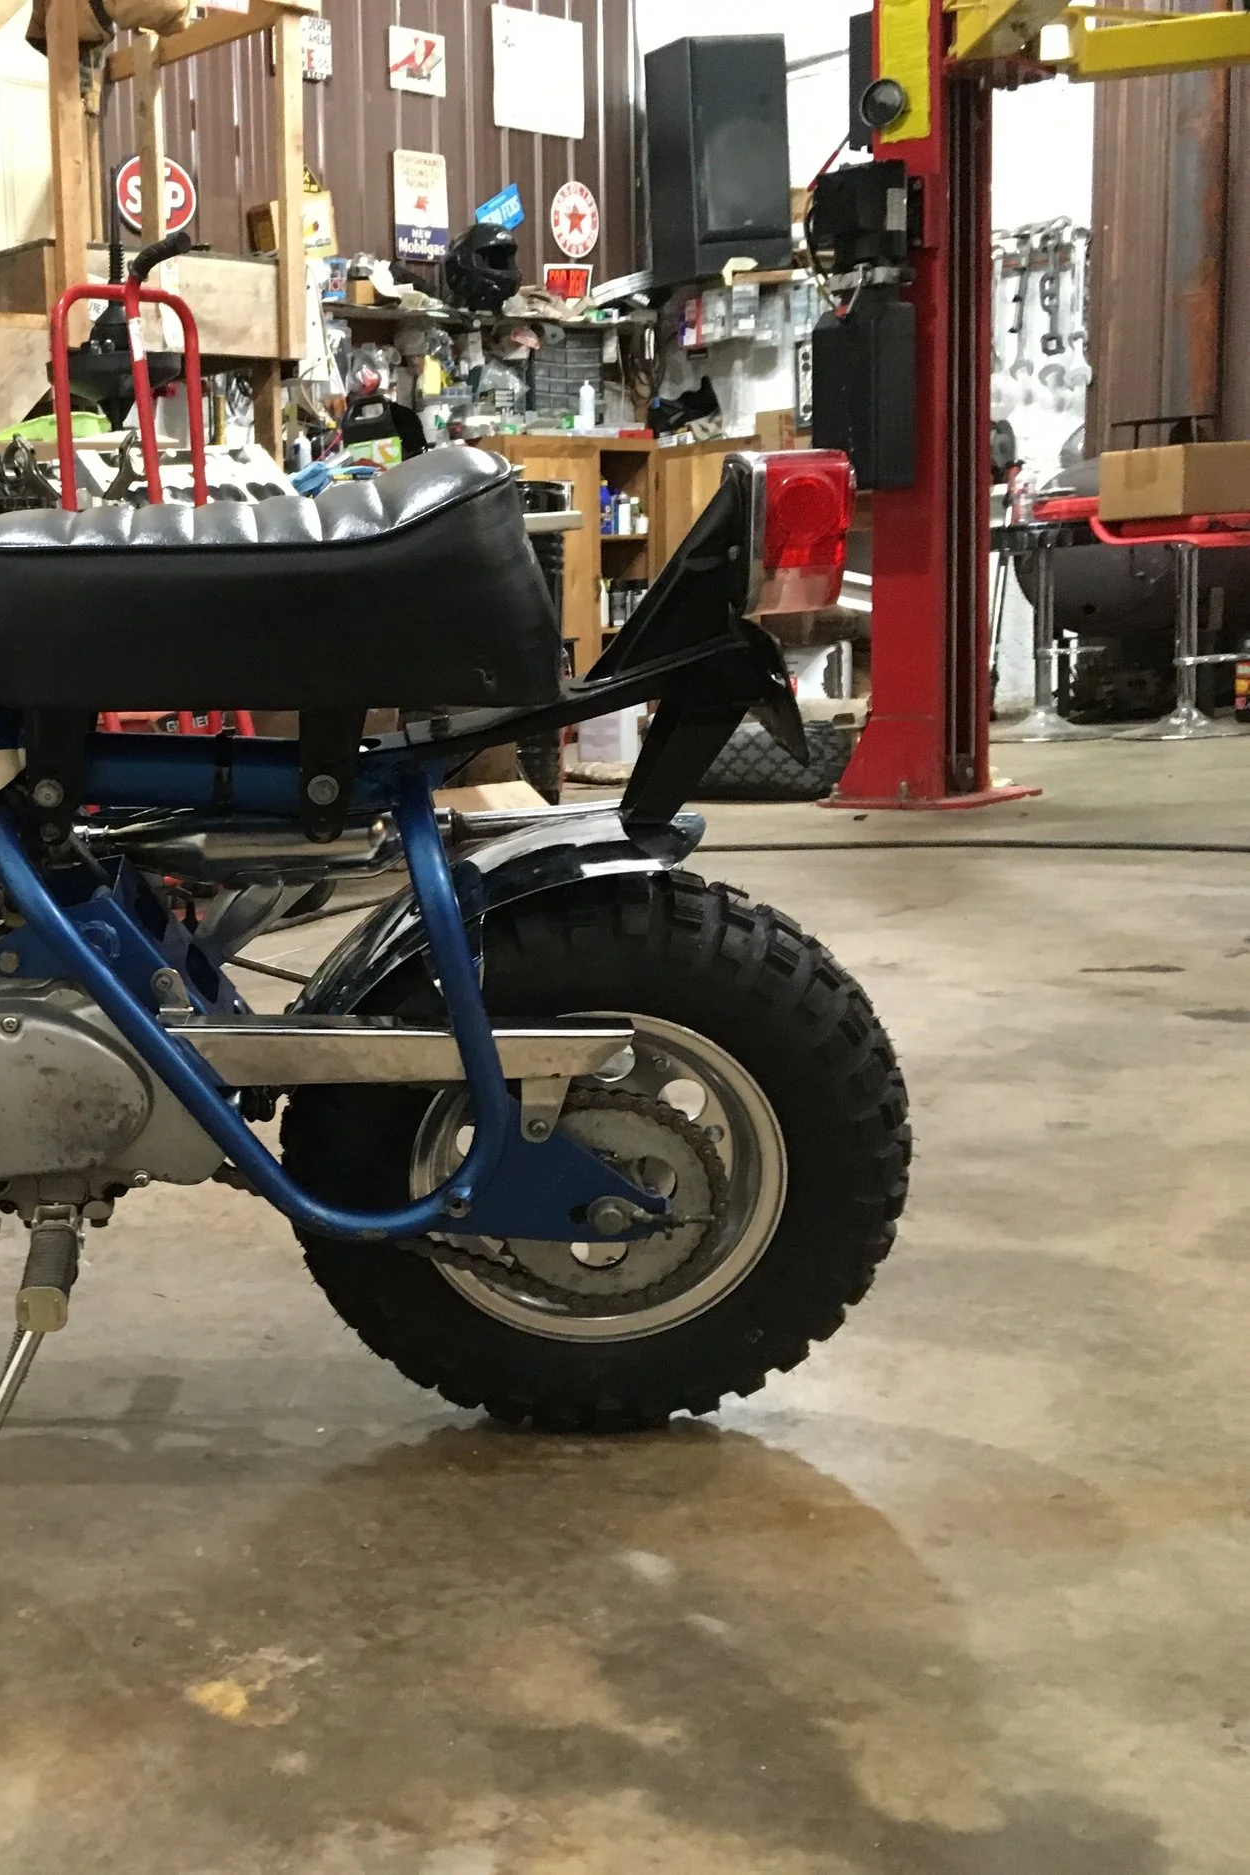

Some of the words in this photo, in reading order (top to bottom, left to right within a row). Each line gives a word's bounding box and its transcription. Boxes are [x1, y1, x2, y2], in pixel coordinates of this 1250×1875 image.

[125, 165, 186, 220] SP
[411, 229, 432, 240] NEW
[398, 237, 447, 260] Mobilgas
